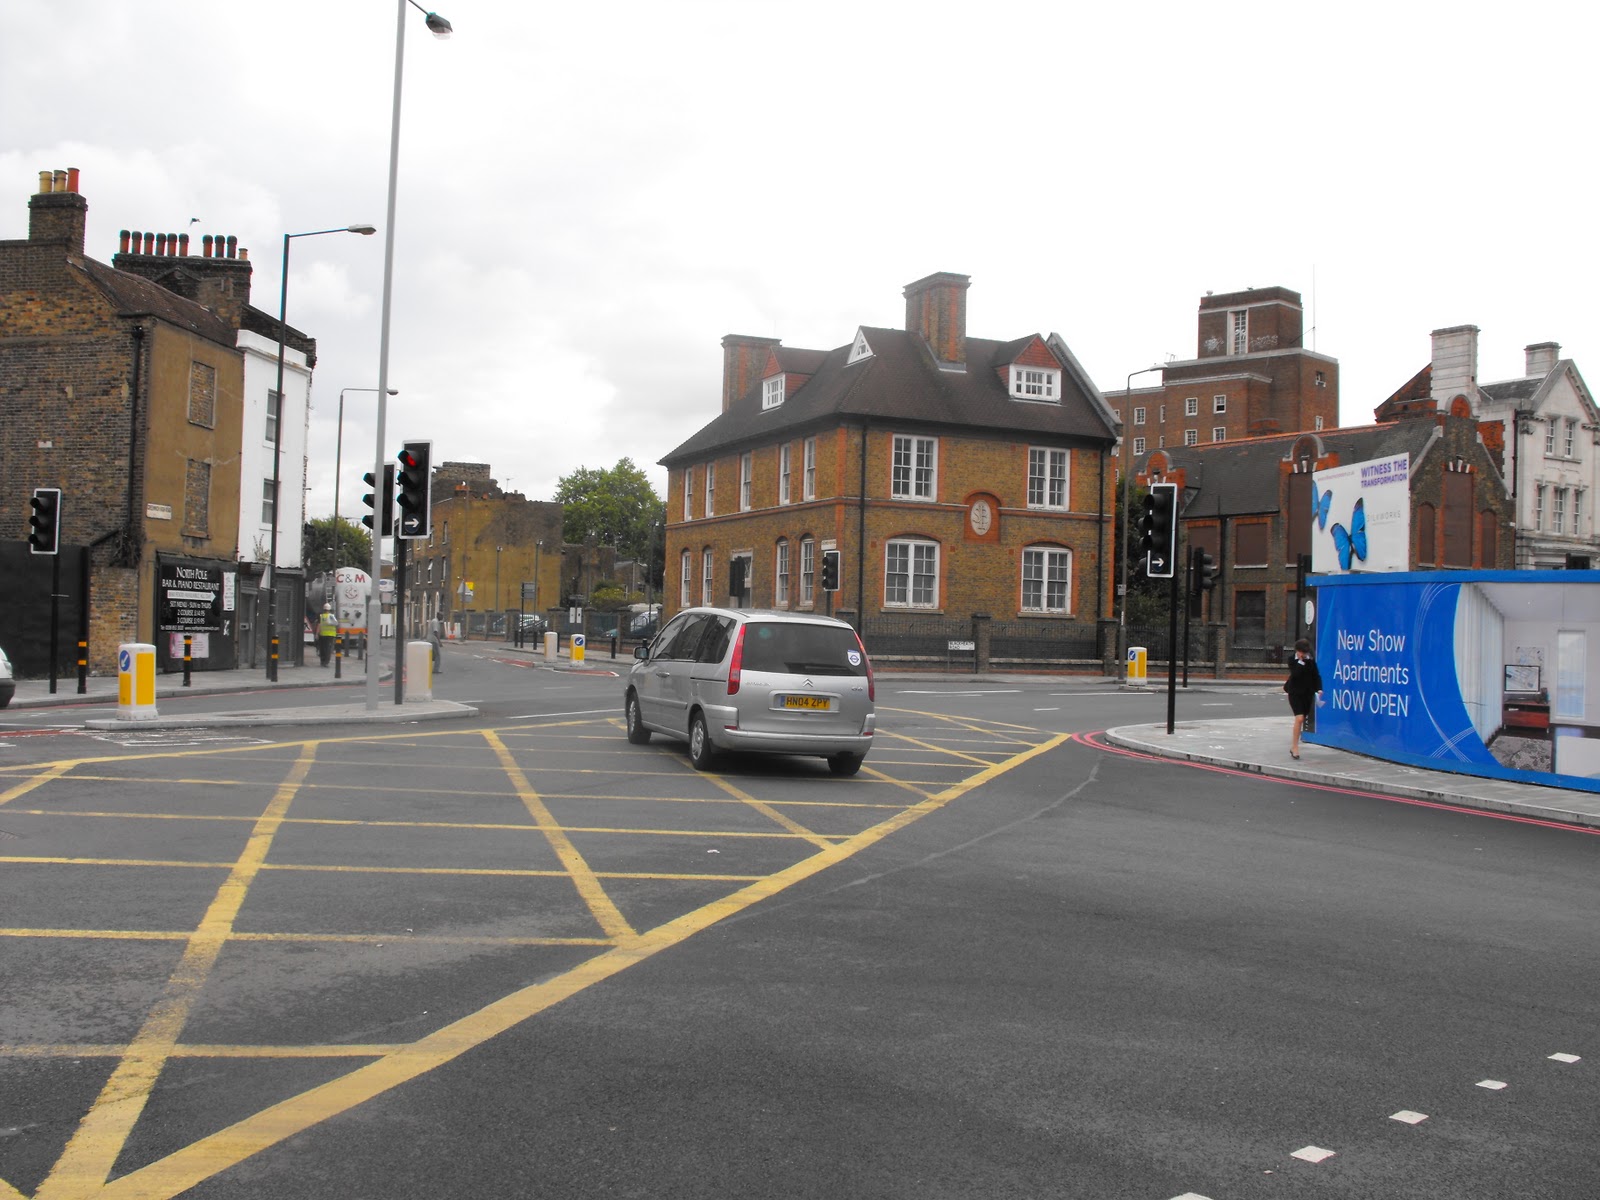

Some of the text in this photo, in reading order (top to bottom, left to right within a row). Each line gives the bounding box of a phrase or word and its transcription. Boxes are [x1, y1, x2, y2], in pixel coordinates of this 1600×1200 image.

[1361, 462, 1392, 478] WITNESS
[1393, 459, 1407, 472] THE
[1361, 473, 1408, 488] TRANSFORMATION
[176, 566, 208, 580] NORTH POLE
[336, 573, 366, 583] C & M
[162, 578, 173, 588] BAR
[177, 580, 193, 589] PIANO
[193, 581, 220, 591] RESTAURANT
[1337, 628, 1406, 652] New Show
[1333, 659, 1409, 685] Apartments
[786, 696, 828, 708] HN04 ZPY
[1332, 688, 1409, 717] NOW OPEN
